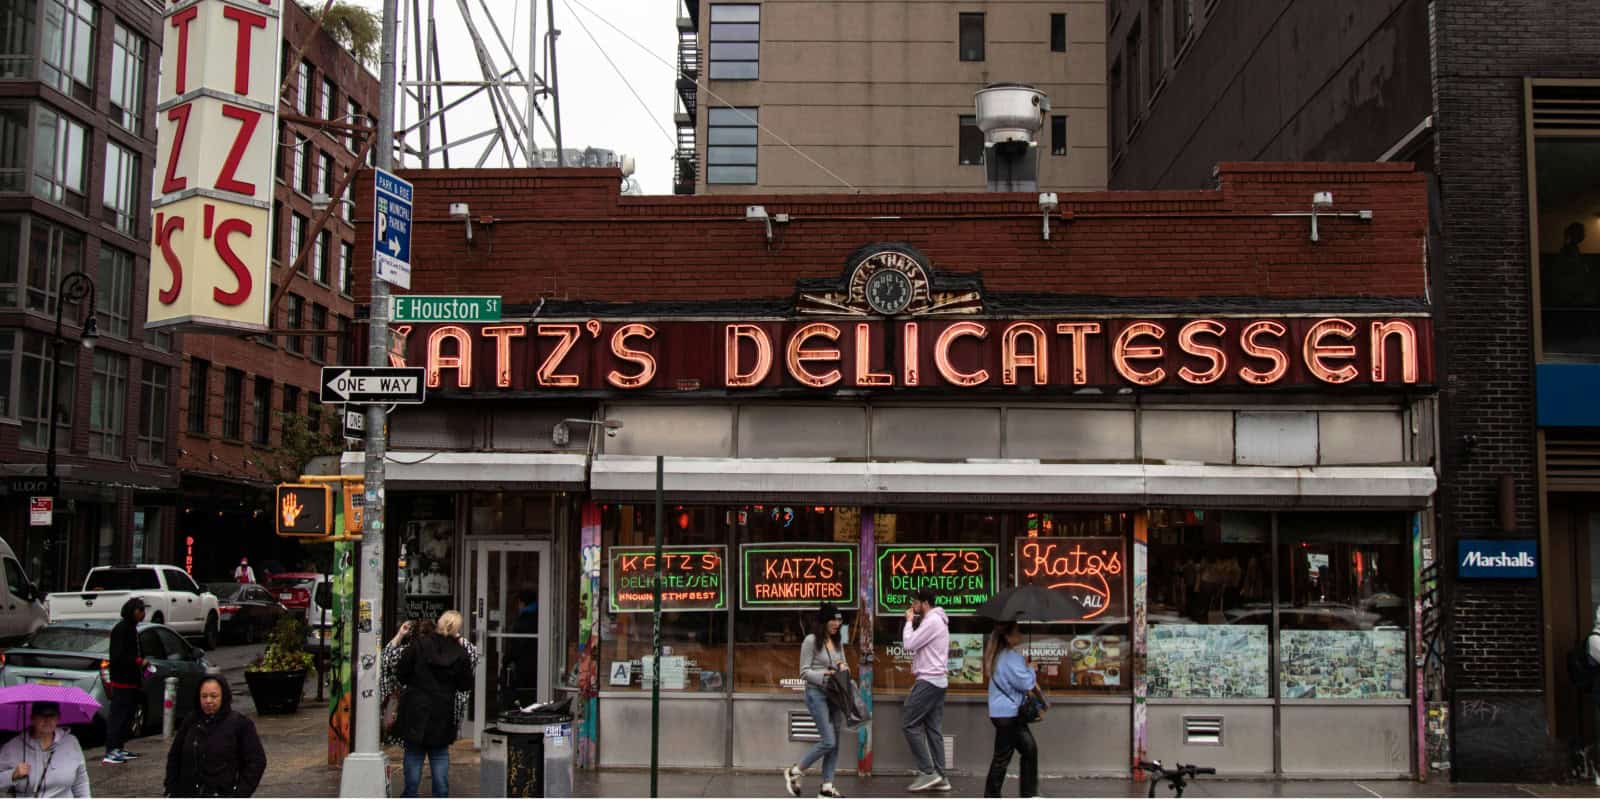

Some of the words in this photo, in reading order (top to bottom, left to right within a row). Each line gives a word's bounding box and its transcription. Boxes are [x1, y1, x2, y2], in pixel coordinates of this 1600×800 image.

[379, 176, 393, 192] PARK
[377, 212, 388, 242] P
[396, 299, 405, 318] E
[410, 299, 480, 319] Houston
[485, 300, 498, 312] St
[725, 318, 1419, 388] DELICATESSEN
[337, 378, 366, 392] ONE
[380, 378, 412, 392] WAY
[891, 550, 981, 575] KATZ'S
[1023, 543, 1123, 578] Katz's
[1461, 551, 1535, 567] Marshalls
[766, 556, 833, 579] KATZ'S
[620, 575, 719, 589] DELICATESSEN
[890, 575, 984, 591] DELICATESSEN
[755, 583, 842, 599] FRANKFURTERS
[886, 594, 907, 605] BEST
[963, 594, 989, 605] TOWN
[1082, 595, 1103, 609] ALL
[1022, 647, 1068, 658] HANUKKAH
[614, 663, 628, 680] A
